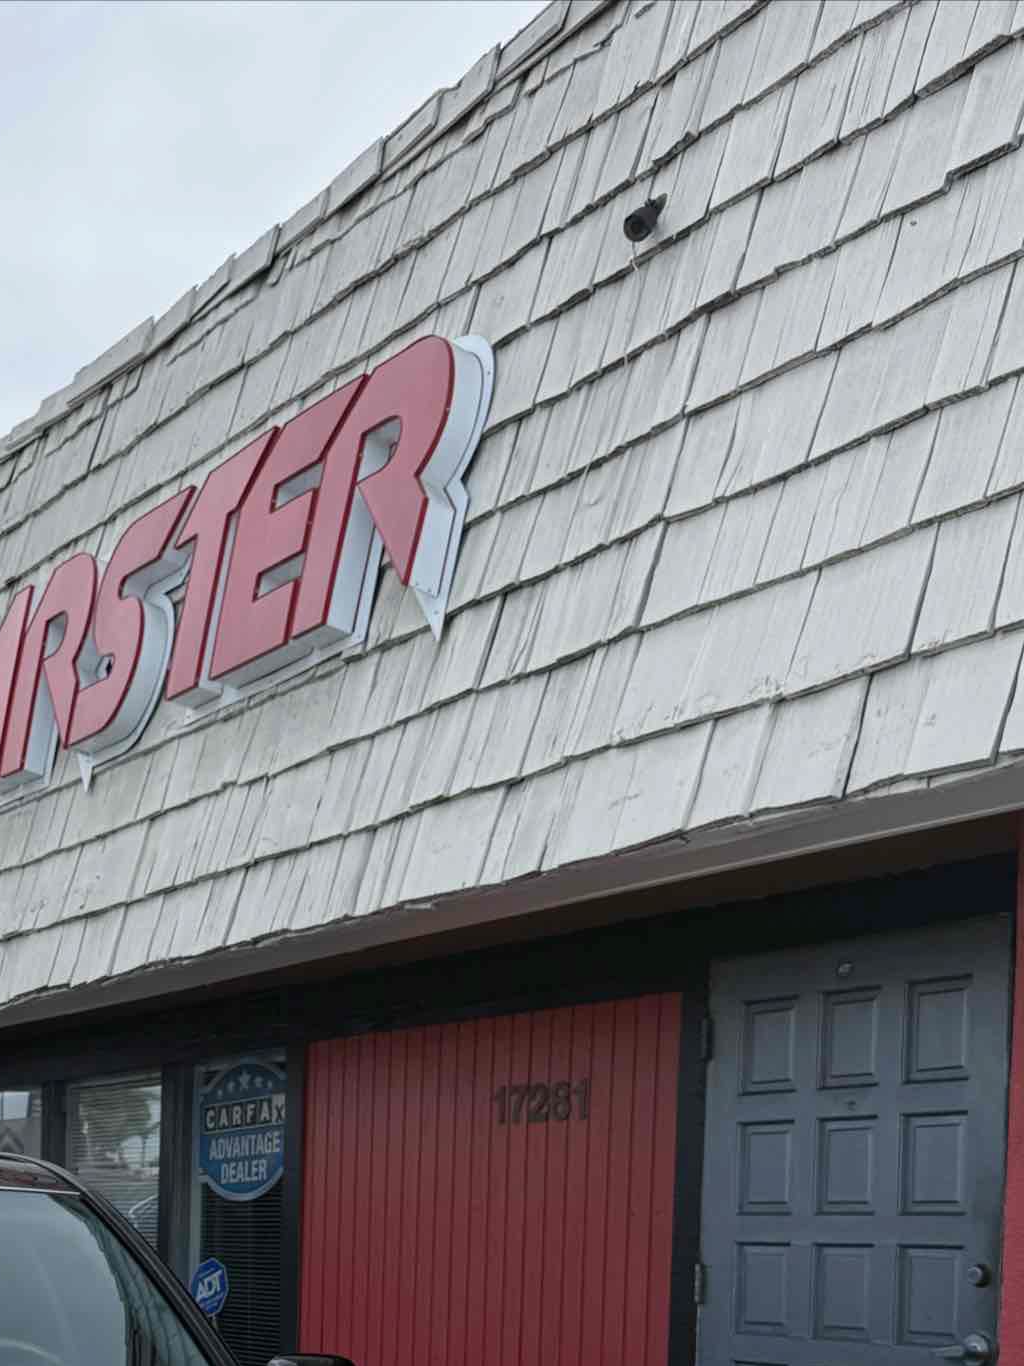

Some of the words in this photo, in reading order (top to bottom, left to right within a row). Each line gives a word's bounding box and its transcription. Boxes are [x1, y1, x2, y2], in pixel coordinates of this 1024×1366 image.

[206, 1098, 286, 1130] CARFAX
[495, 1080, 590, 1123] 17281
[208, 1131, 281, 1161] ADVANTAGE
[220, 1159, 268, 1185] DEALER
[196, 1270, 223, 1303] ADT
